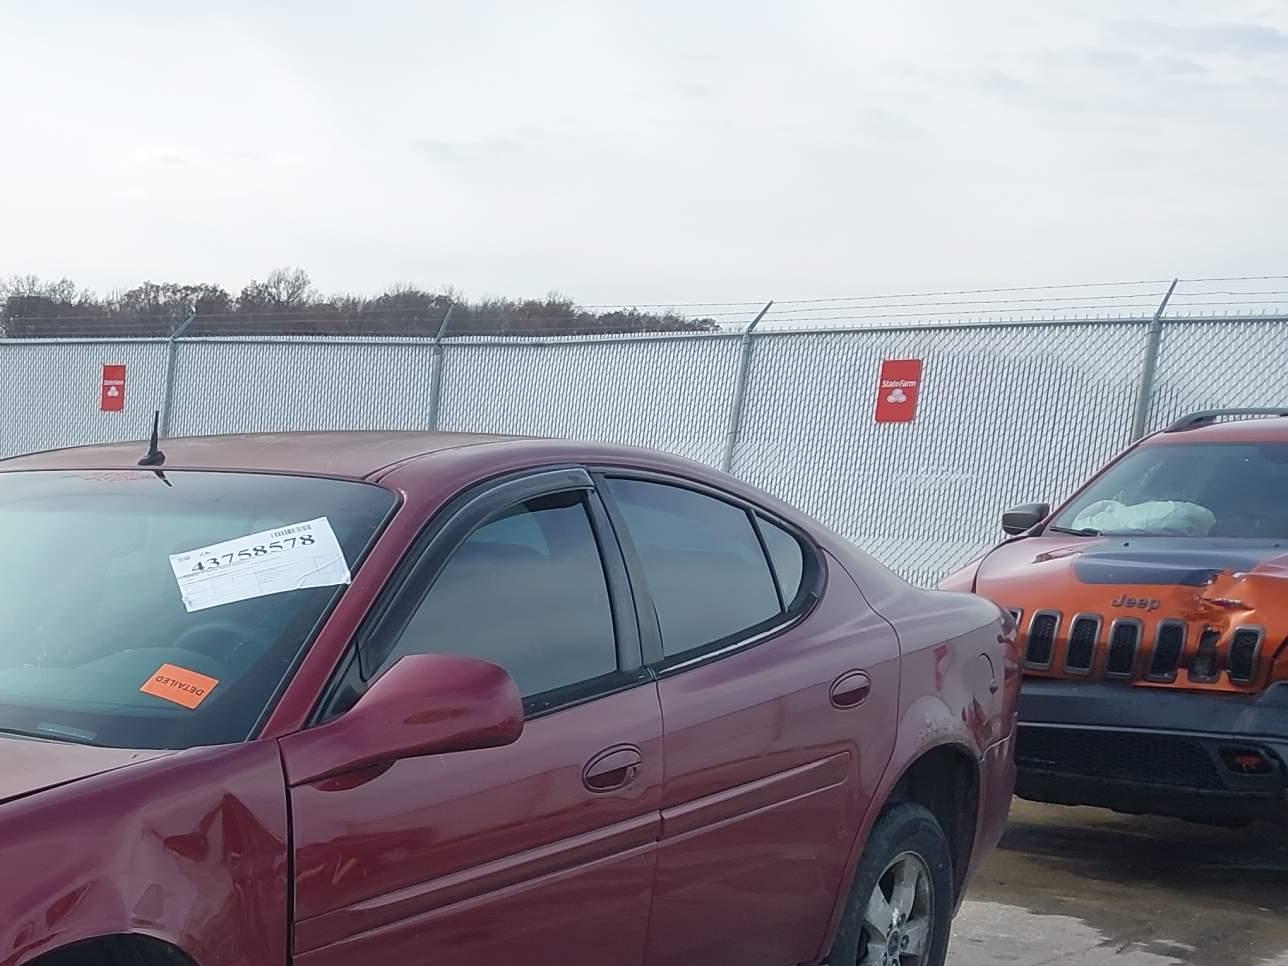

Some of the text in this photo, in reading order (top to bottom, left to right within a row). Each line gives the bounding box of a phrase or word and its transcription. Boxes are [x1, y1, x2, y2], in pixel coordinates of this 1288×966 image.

[190, 533, 316, 573] 43758578
[1111, 594, 1161, 612] Jeep
[155, 675, 205, 697] DETAILED
